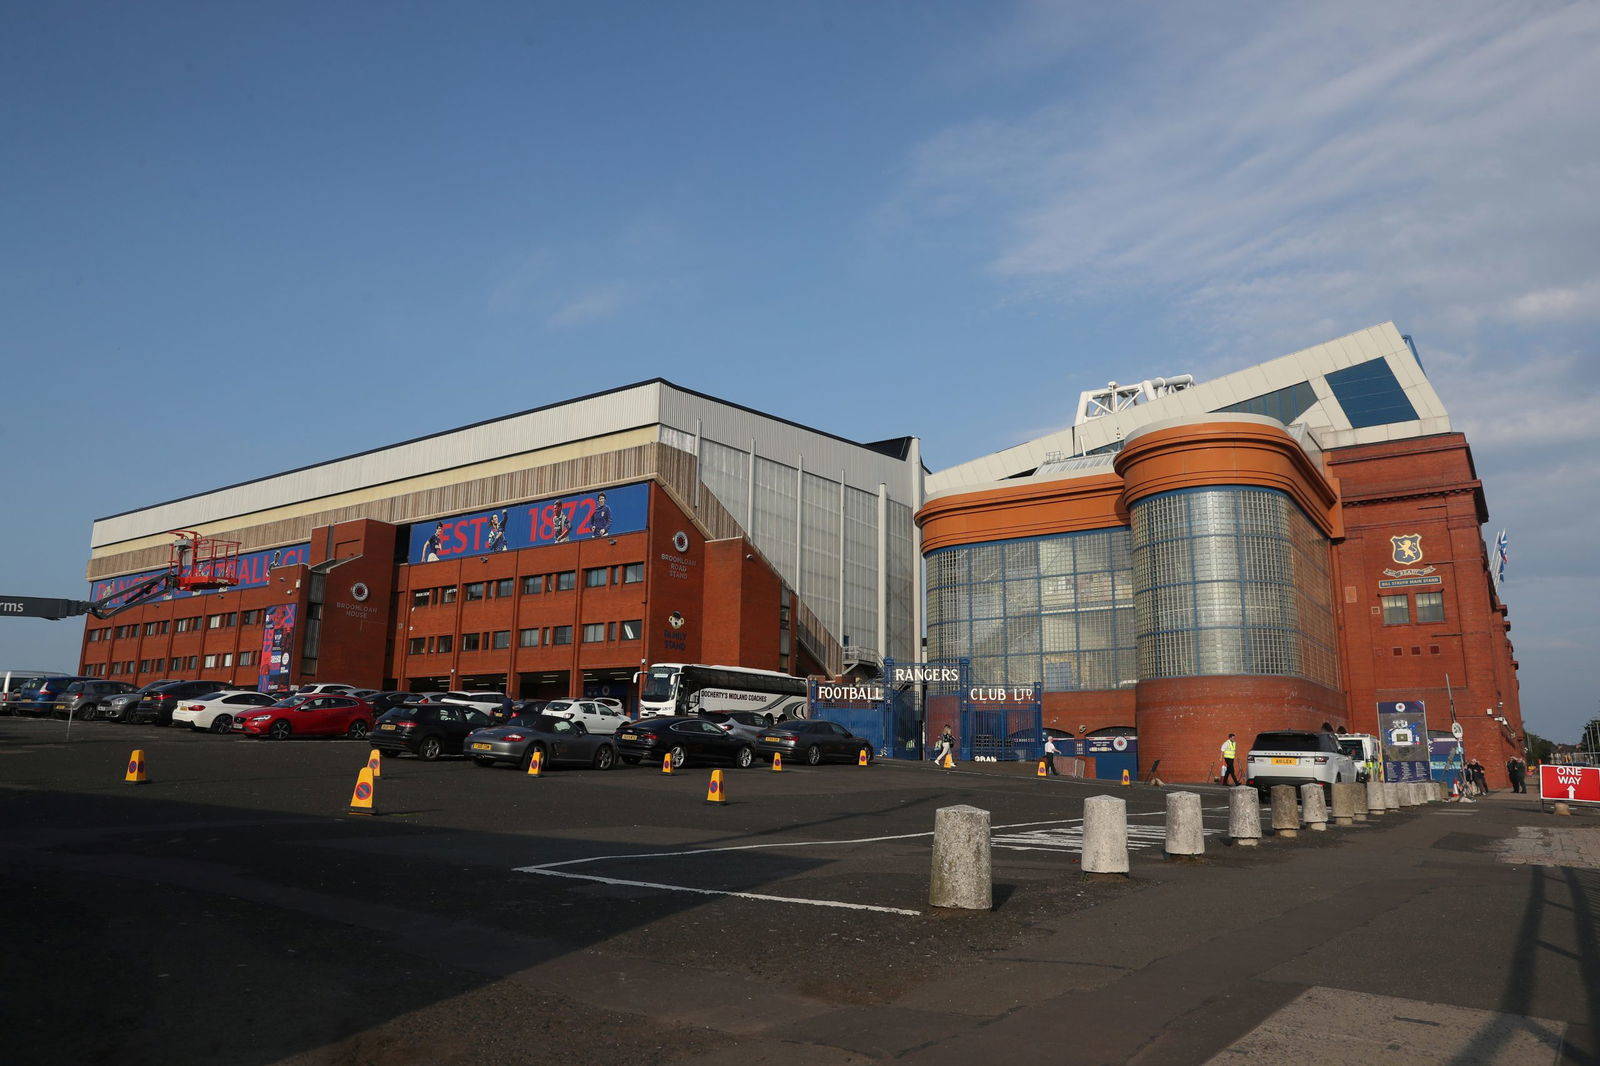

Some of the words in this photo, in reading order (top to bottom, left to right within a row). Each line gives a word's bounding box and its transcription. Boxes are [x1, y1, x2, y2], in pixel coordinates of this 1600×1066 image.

[528, 498, 597, 542] 1872
[670, 563, 687, 573] ROAD
[669, 570, 688, 580] STAND
[346, 610, 369, 619] HOUSE
[894, 668, 959, 681] RANGERS
[729, 692, 748, 700] MIDLAND
[748, 694, 767, 703] COACHES
[818, 686, 884, 700] FOOTBALL
[970, 688, 1007, 701] CLUB
[1556, 766, 1582, 776] ONE
[1557, 776, 1582, 785] WAY
